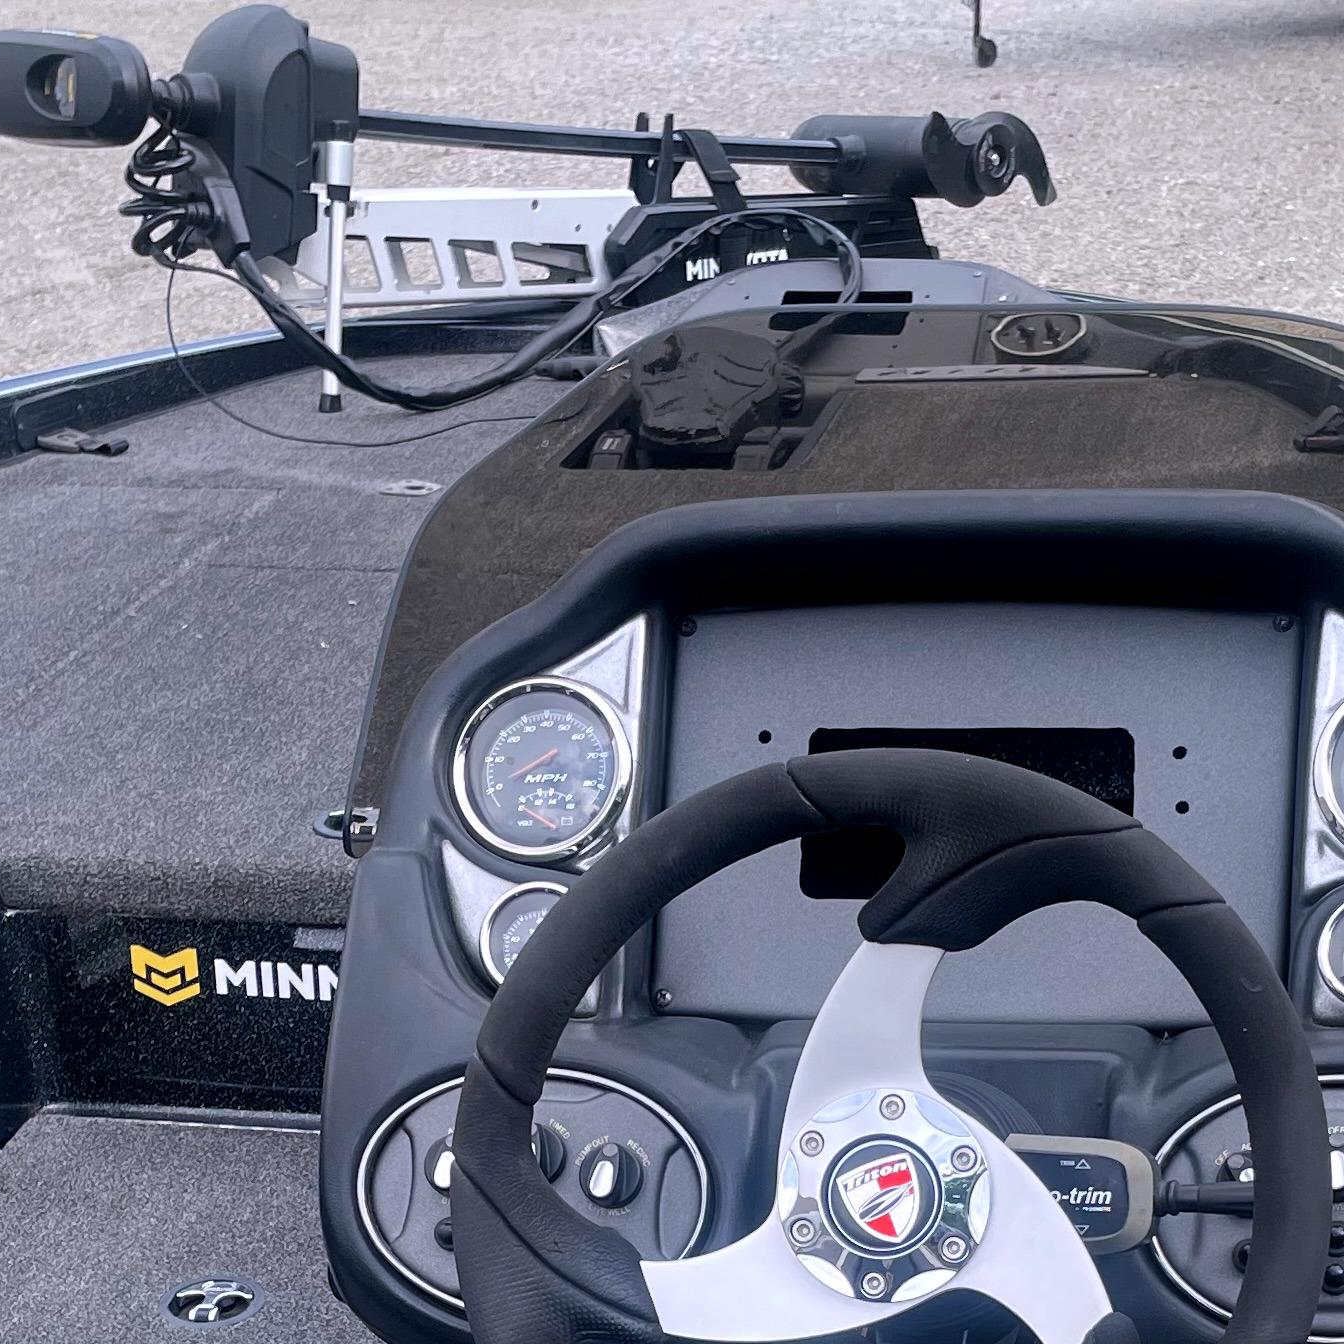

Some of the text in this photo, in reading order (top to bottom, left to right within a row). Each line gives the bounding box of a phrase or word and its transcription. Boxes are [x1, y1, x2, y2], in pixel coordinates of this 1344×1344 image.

[524, 773, 567, 783] MPH
[549, 1118, 570, 1140] TIMED
[627, 1139, 651, 1168] RECIRC
[842, 1158, 909, 1192] Triton
